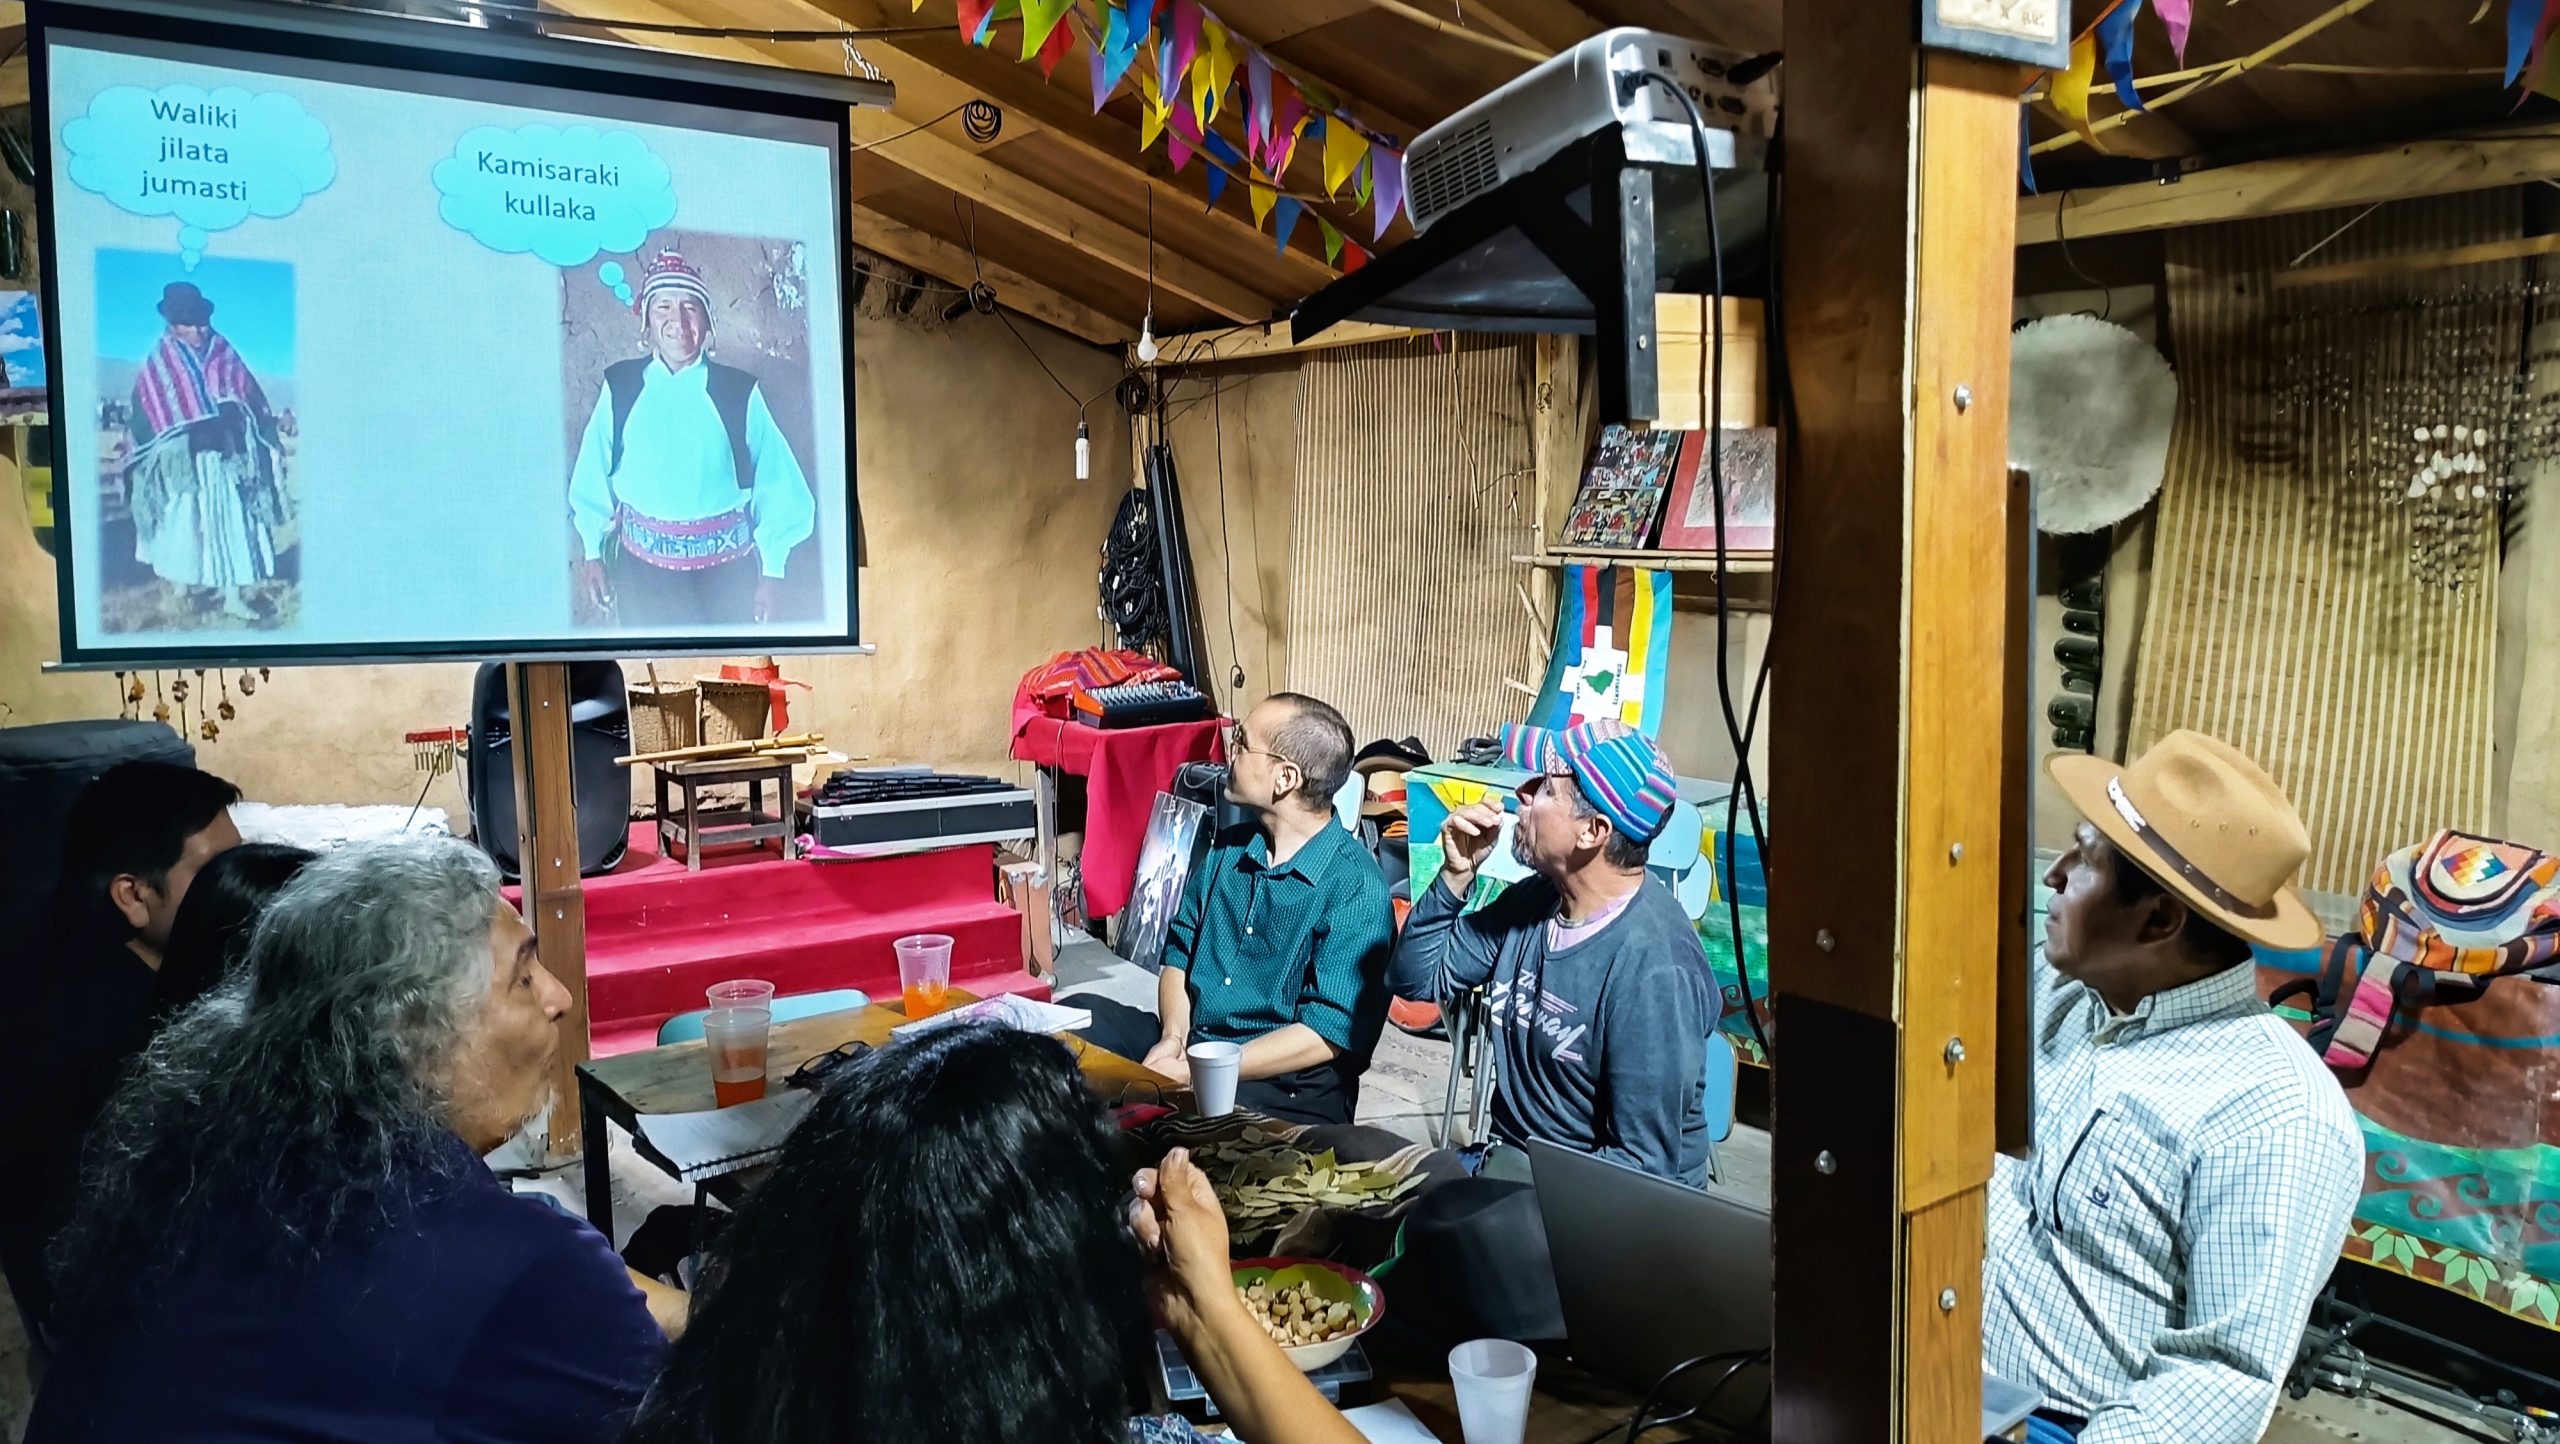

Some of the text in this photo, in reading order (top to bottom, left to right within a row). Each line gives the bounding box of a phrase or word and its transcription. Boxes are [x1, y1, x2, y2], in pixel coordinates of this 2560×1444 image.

[150, 98, 237, 129] Waliki
[158, 136, 229, 164] jilata
[478, 150, 619, 187] Kamisaraki
[140, 169, 247, 201] jumasti
[505, 190, 596, 221] kullaka
